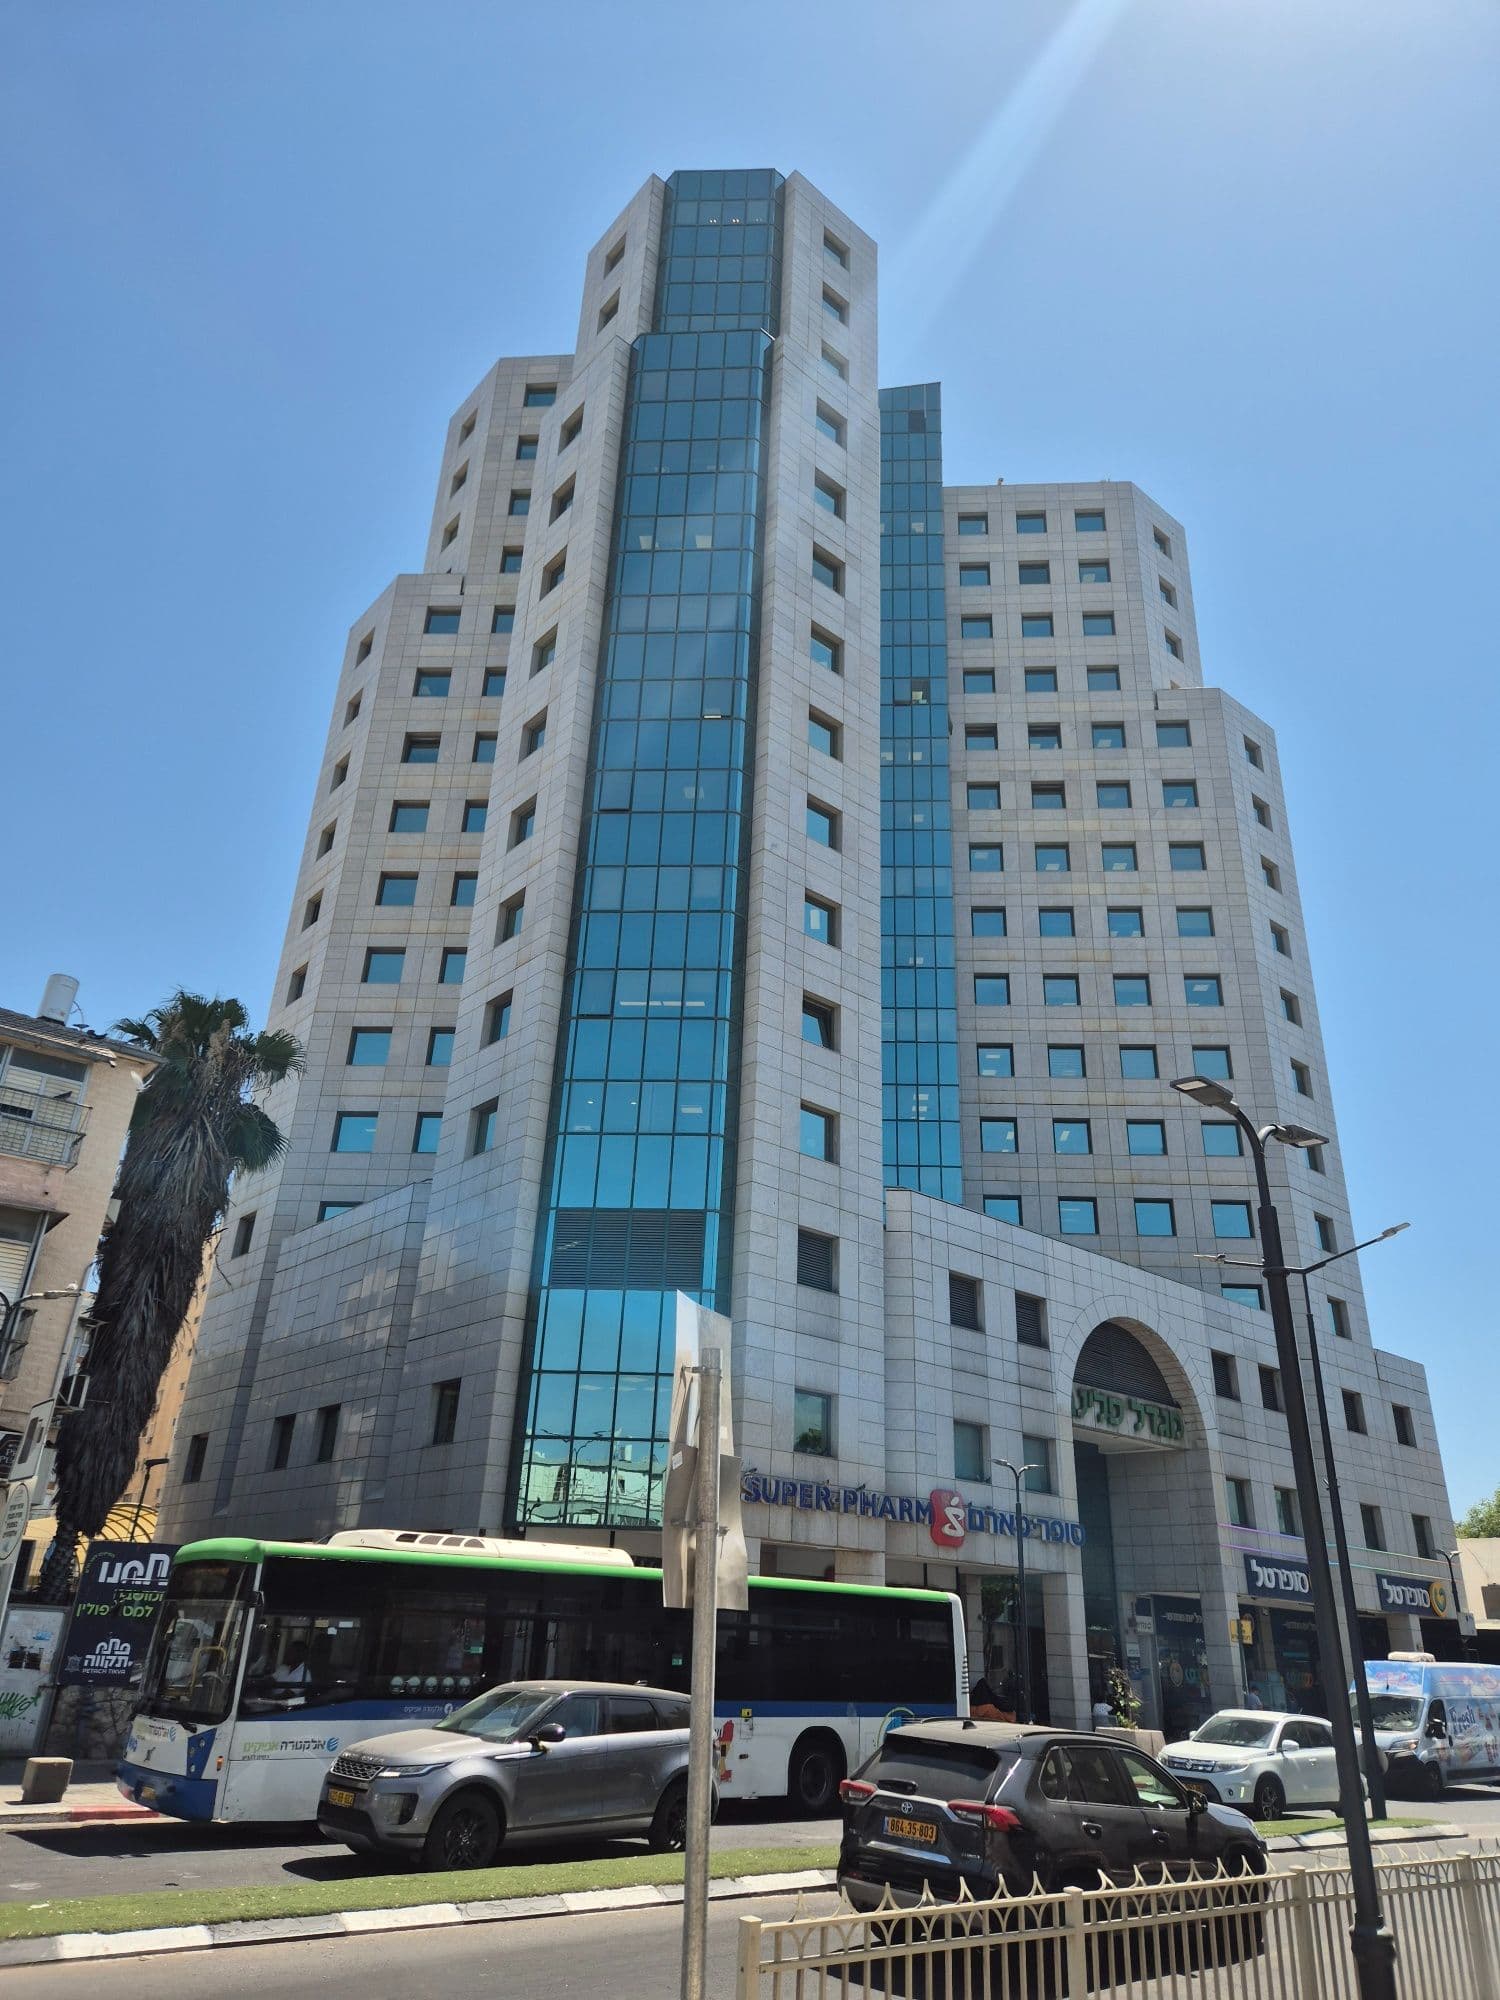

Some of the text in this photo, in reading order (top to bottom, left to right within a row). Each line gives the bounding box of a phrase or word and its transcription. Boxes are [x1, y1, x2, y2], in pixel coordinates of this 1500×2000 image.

[1251, 1559, 1309, 1593] סופרטל
[1382, 1578, 1430, 1608] סופרטל
[95, 1638, 131, 1655] פתח
[83, 1654, 129, 1668] תקווה
[280, 1738, 325, 1752] אלקטרה
